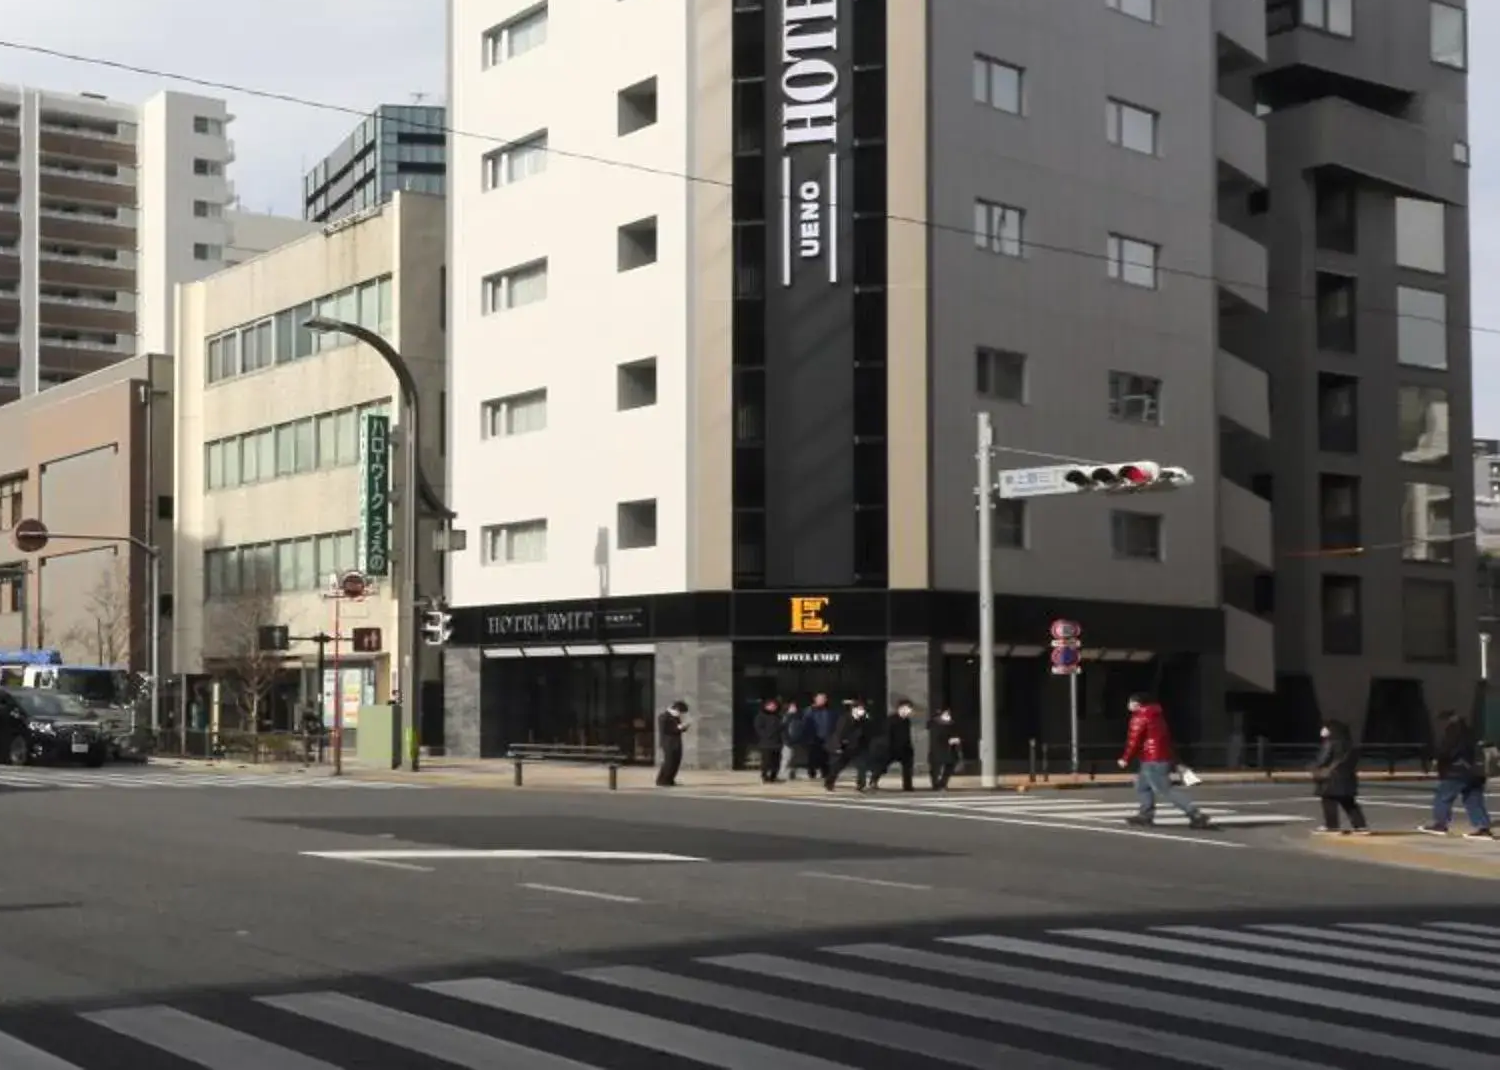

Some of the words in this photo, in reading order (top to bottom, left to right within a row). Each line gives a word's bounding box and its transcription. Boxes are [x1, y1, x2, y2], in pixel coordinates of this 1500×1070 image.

[800, 180, 820, 258] UENO
[370, 417, 385, 510] ハローワーク
[369, 516, 385, 571] うえの
